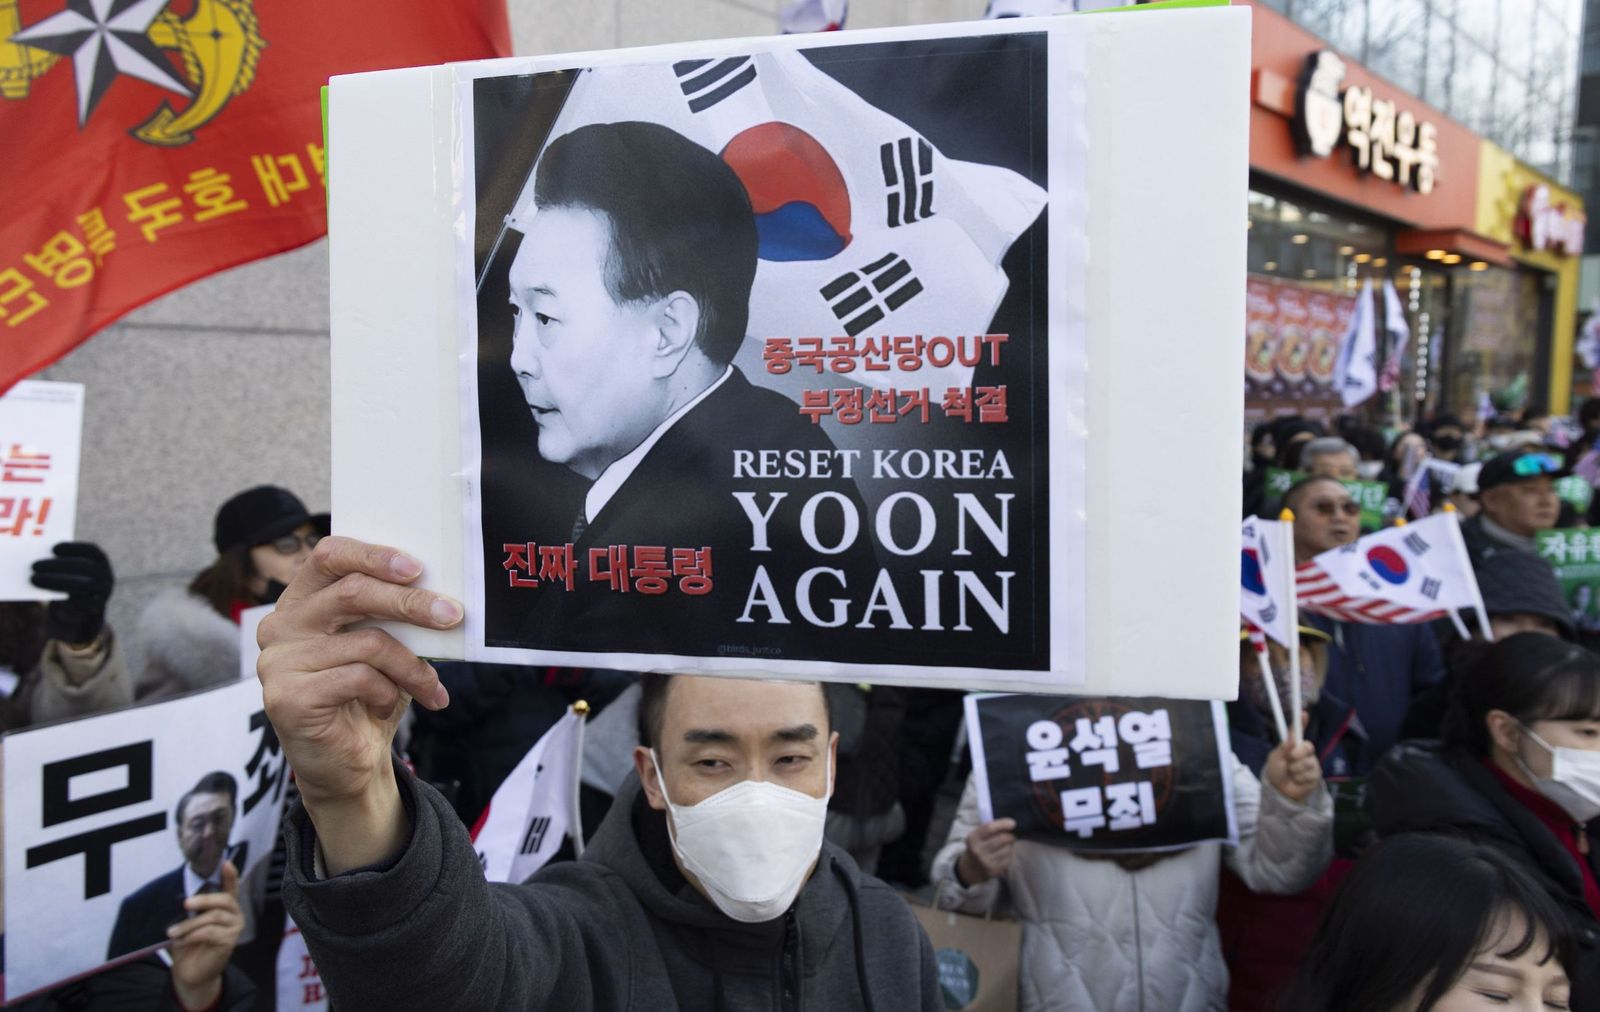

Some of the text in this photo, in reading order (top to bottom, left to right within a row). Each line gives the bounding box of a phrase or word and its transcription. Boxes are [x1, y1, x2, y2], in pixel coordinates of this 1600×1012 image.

[763, 333, 1009, 375] 중국공산당OUT
[800, 385, 1009, 424] 부정선거 척결
[0, 443, 50, 484] 는
[732, 449, 1015, 480] RESET KOREA
[731, 491, 1016, 558] YOON
[1538, 531, 1600, 564] 자유
[502, 541, 714, 596] 진짜 대통령
[735, 564, 1016, 635] AGAIN
[1025, 708, 1172, 783] 윤석열
[1060, 780, 1157, 839] 무죄
